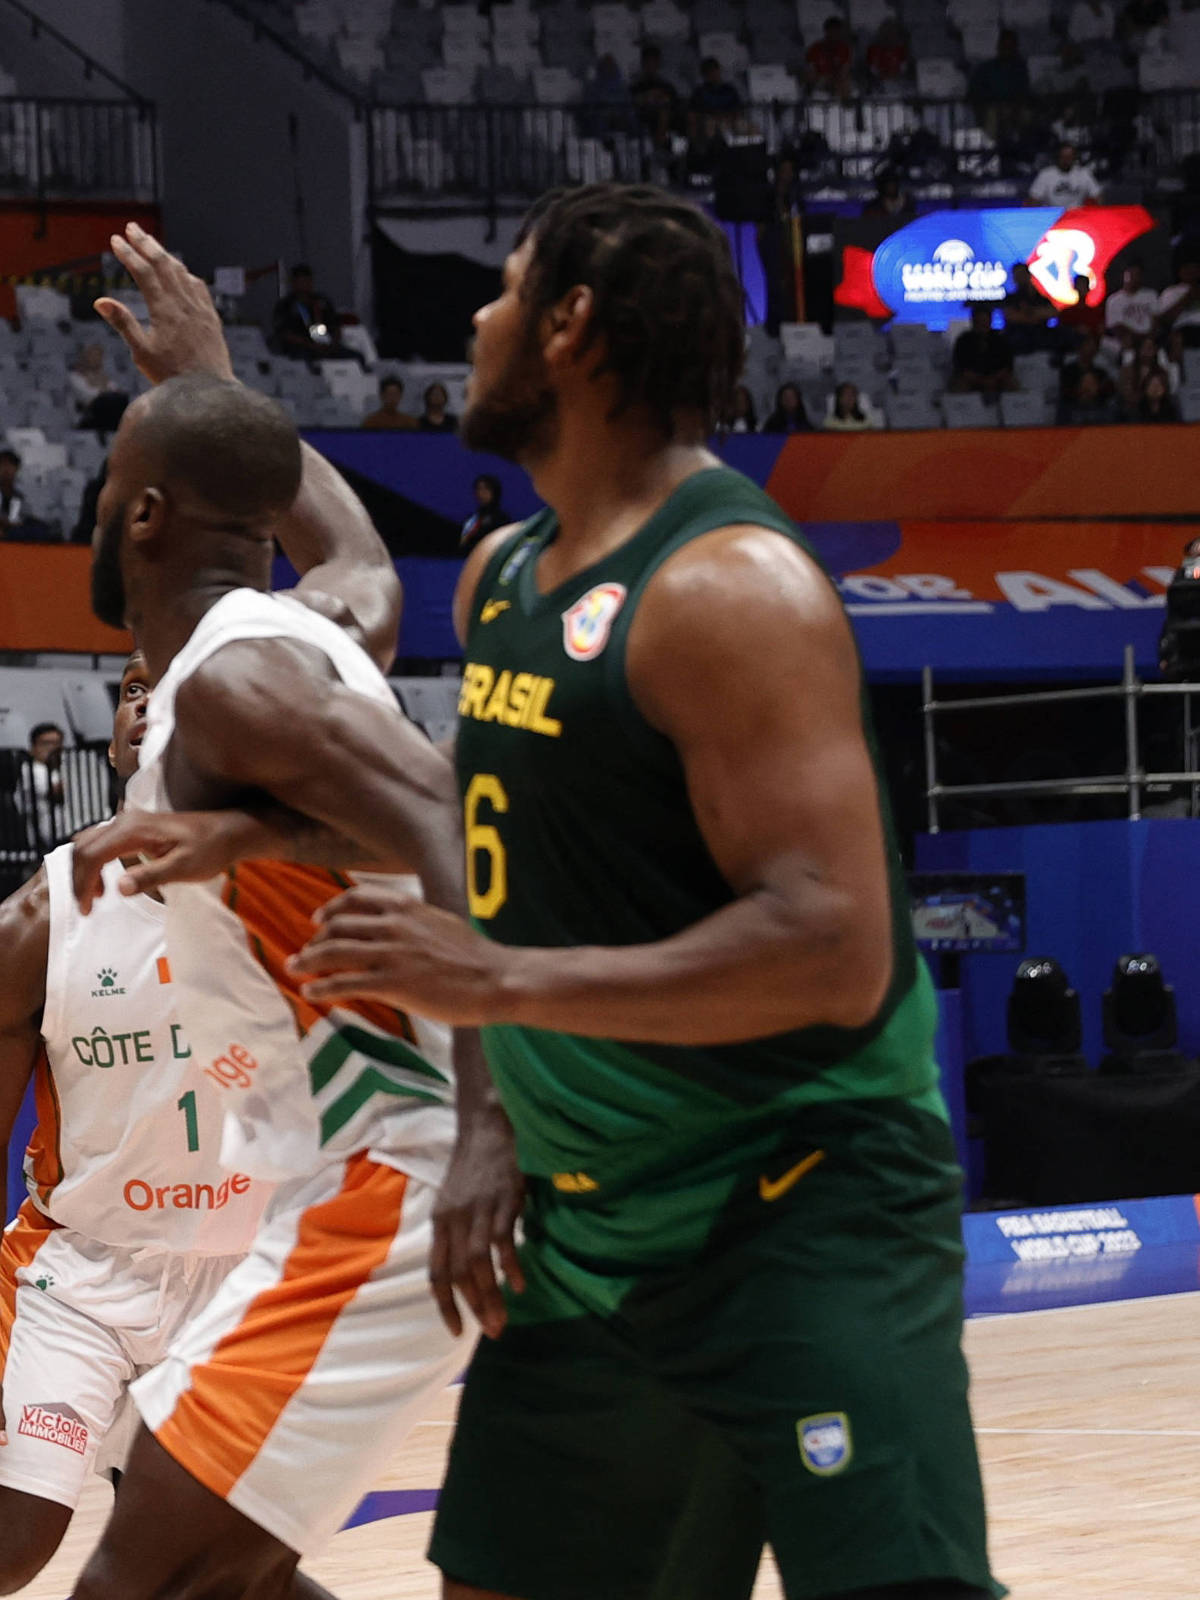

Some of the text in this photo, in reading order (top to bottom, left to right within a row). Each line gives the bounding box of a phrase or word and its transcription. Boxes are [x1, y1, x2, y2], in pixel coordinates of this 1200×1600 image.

[837, 573, 974, 600] OR
[464, 773, 509, 919] 6
[91, 987, 126, 998] KELME
[71, 1023, 192, 1068] CÔTE D
[177, 1089, 200, 1152] 1
[123, 1173, 251, 1211] Orange
[23, 1404, 88, 1442] Victoire
